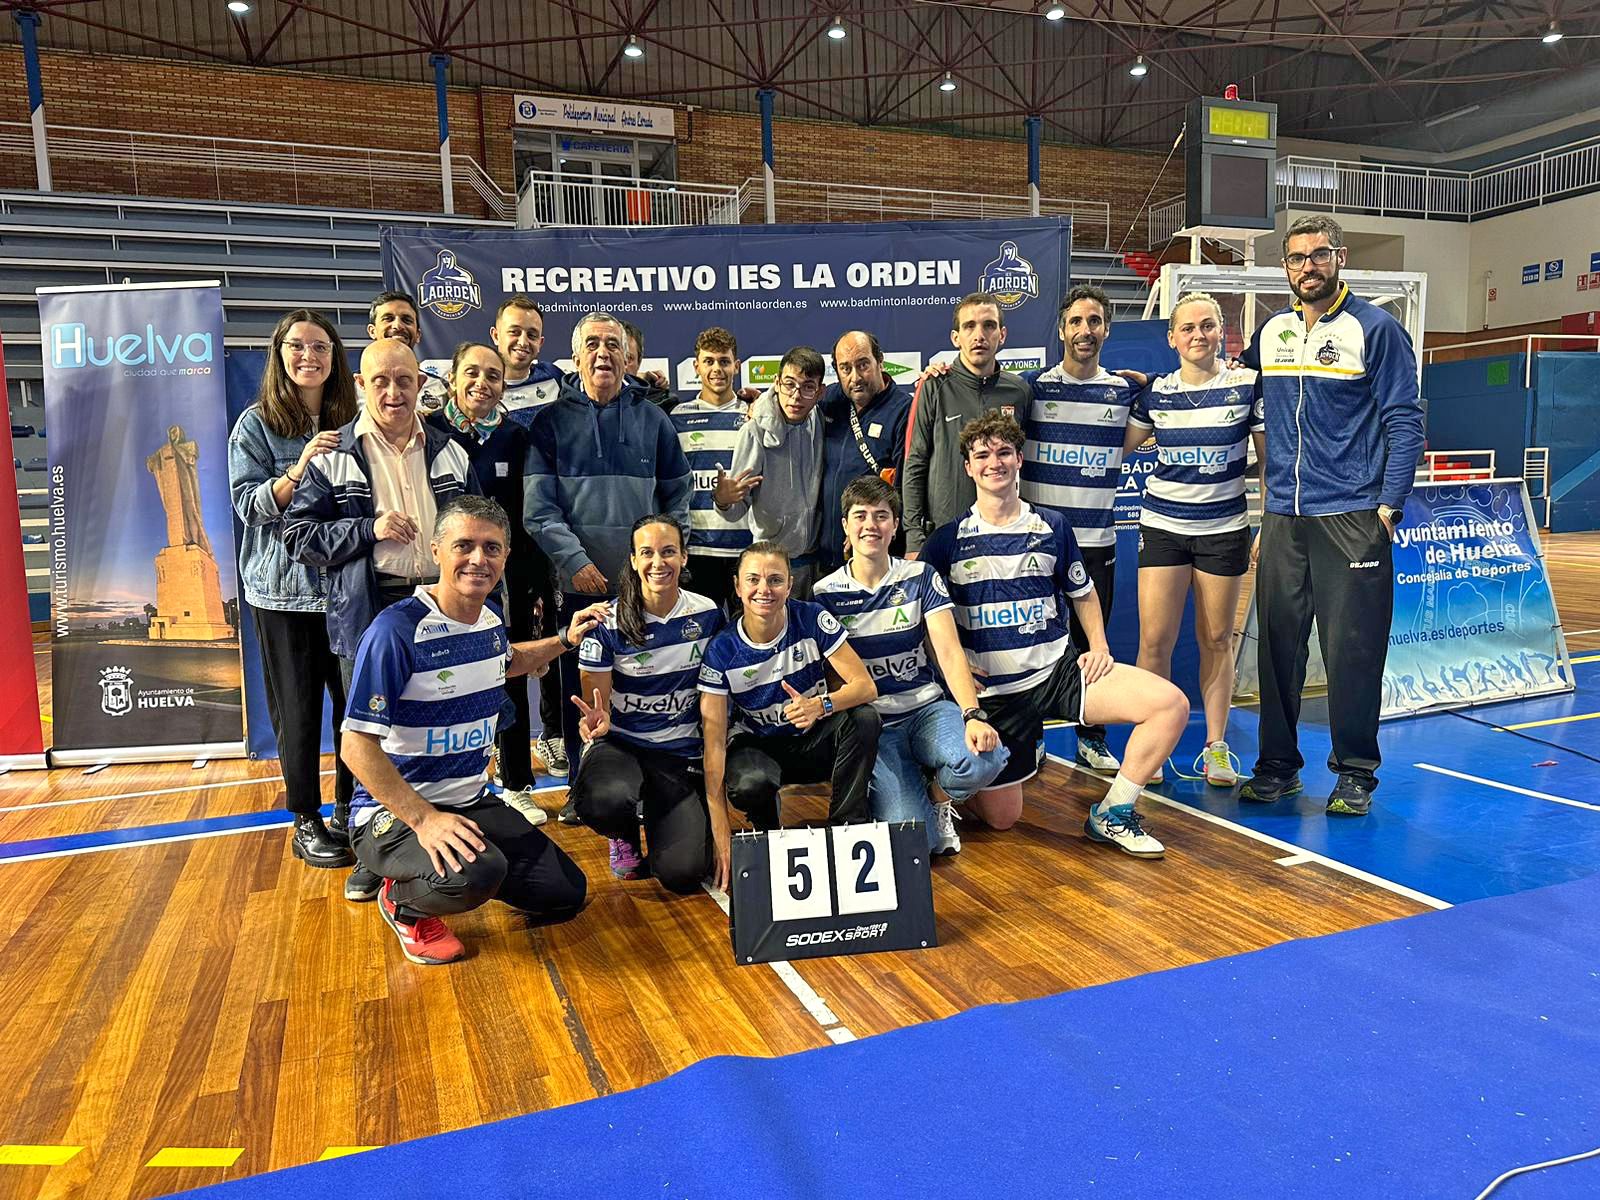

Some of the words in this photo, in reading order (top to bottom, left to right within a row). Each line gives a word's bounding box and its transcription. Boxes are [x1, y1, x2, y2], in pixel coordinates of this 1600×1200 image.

[502, 265, 716, 293] RECREATIVO
[728, 264, 781, 290] IES
[793, 263, 836, 289] LA
[846, 259, 961, 288] ORDEN
[664, 298, 807, 311] www.badmintonlaorden.es
[820, 295, 962, 309] www.badmintonlaorden.es
[52, 323, 213, 368] Huelva
[124, 369, 157, 377] ciudad
[178, 367, 211, 376] marca
[1013, 360, 1039, 369] YONEX
[1037, 443, 1107, 467] Huelva
[51, 465, 69, 638] www.turismo.huelva.es
[1425, 546, 1447, 565] de
[1451, 541, 1524, 563] Huelva
[1455, 568, 1469, 579] de
[1472, 561, 1532, 577] Deportes
[967, 602, 1044, 628] Huelva
[138, 688, 184, 697] Ayuntamiento
[185, 687, 195, 695] de
[138, 696, 195, 708] HUELVA
[787, 847, 813, 900] 5
[851, 840, 880, 894] 2
[786, 929, 846, 947] SODEX
[844, 927, 887, 941] SPORT
